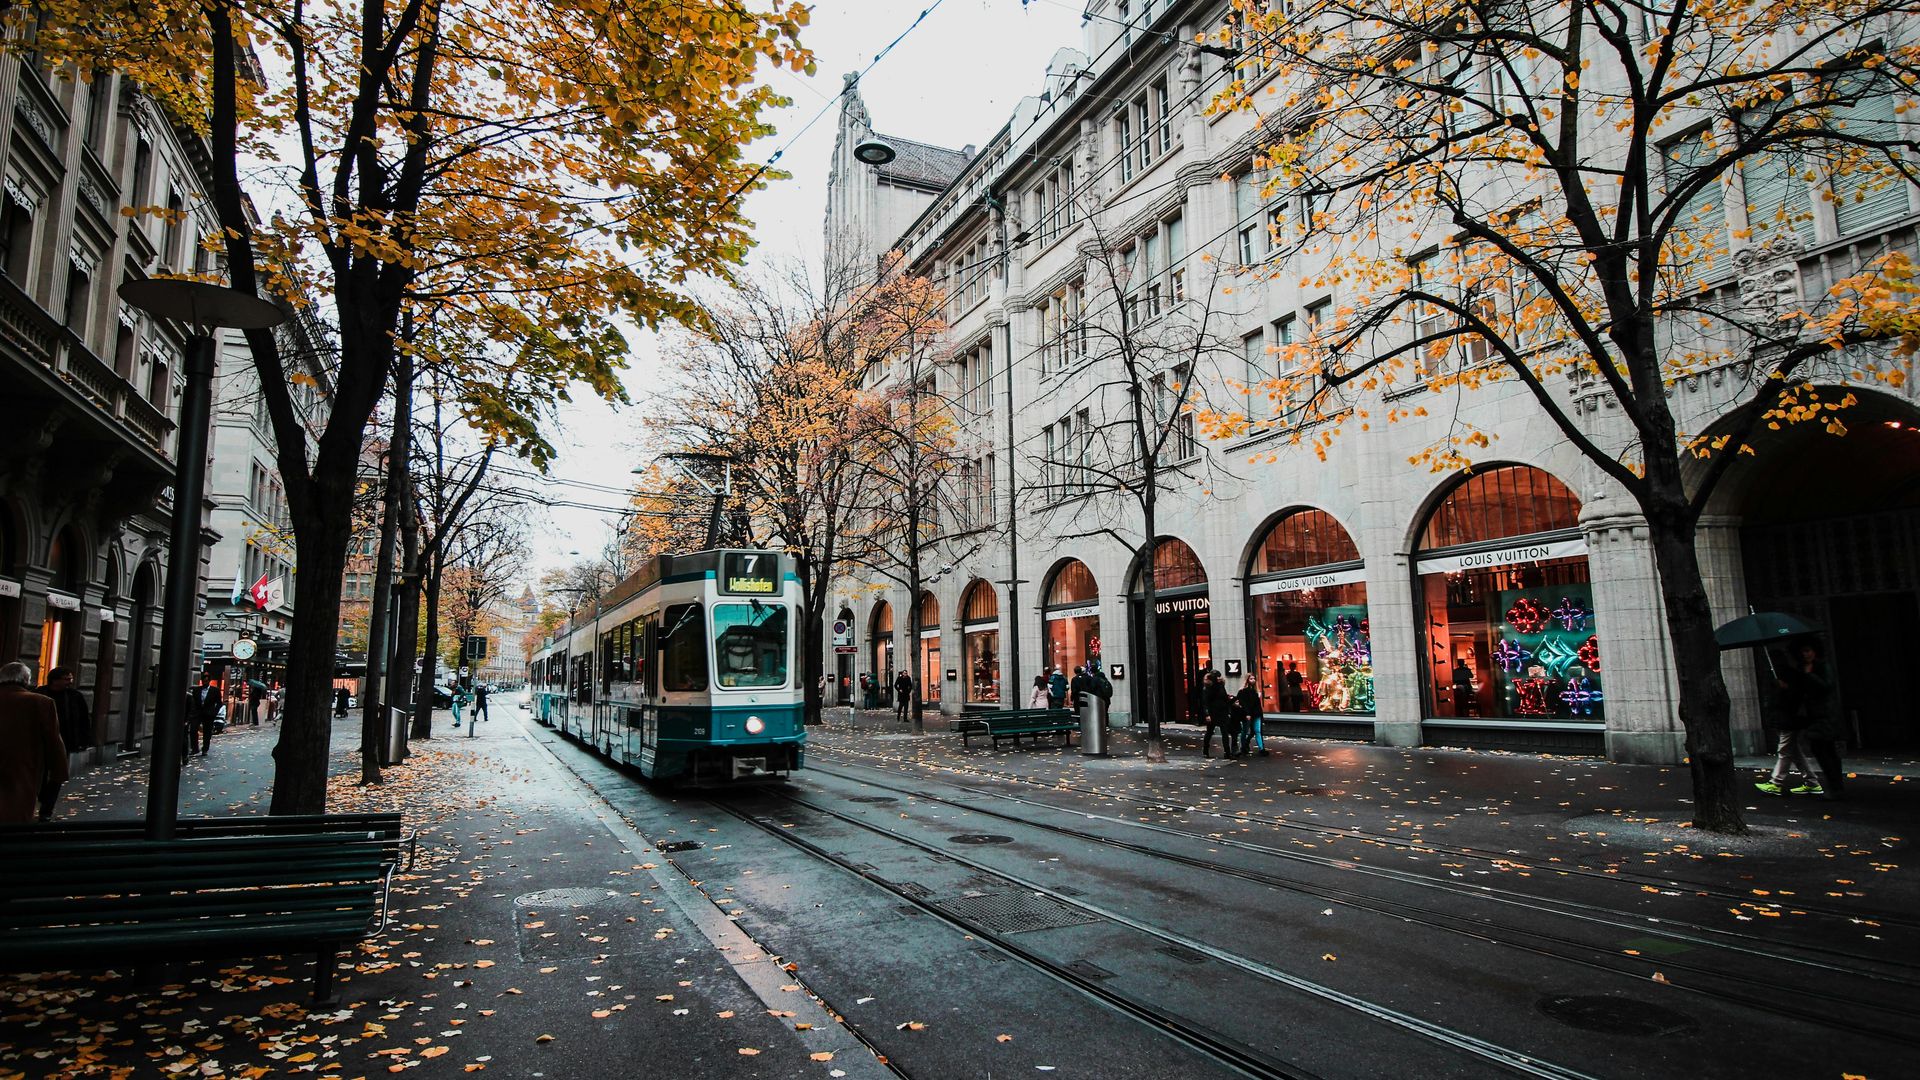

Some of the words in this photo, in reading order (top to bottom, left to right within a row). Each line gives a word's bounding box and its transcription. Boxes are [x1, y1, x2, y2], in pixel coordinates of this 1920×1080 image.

[744, 554, 759, 574] 7
[1460, 554, 1492, 567] LOUIS
[1496, 546, 1549, 562] VUITTON
[729, 577, 773, 592] Wollishofen
[1277, 579, 1299, 590] LOUIS
[1301, 575, 1336, 586] VUITTON
[1155, 602, 1170, 614] UIS
